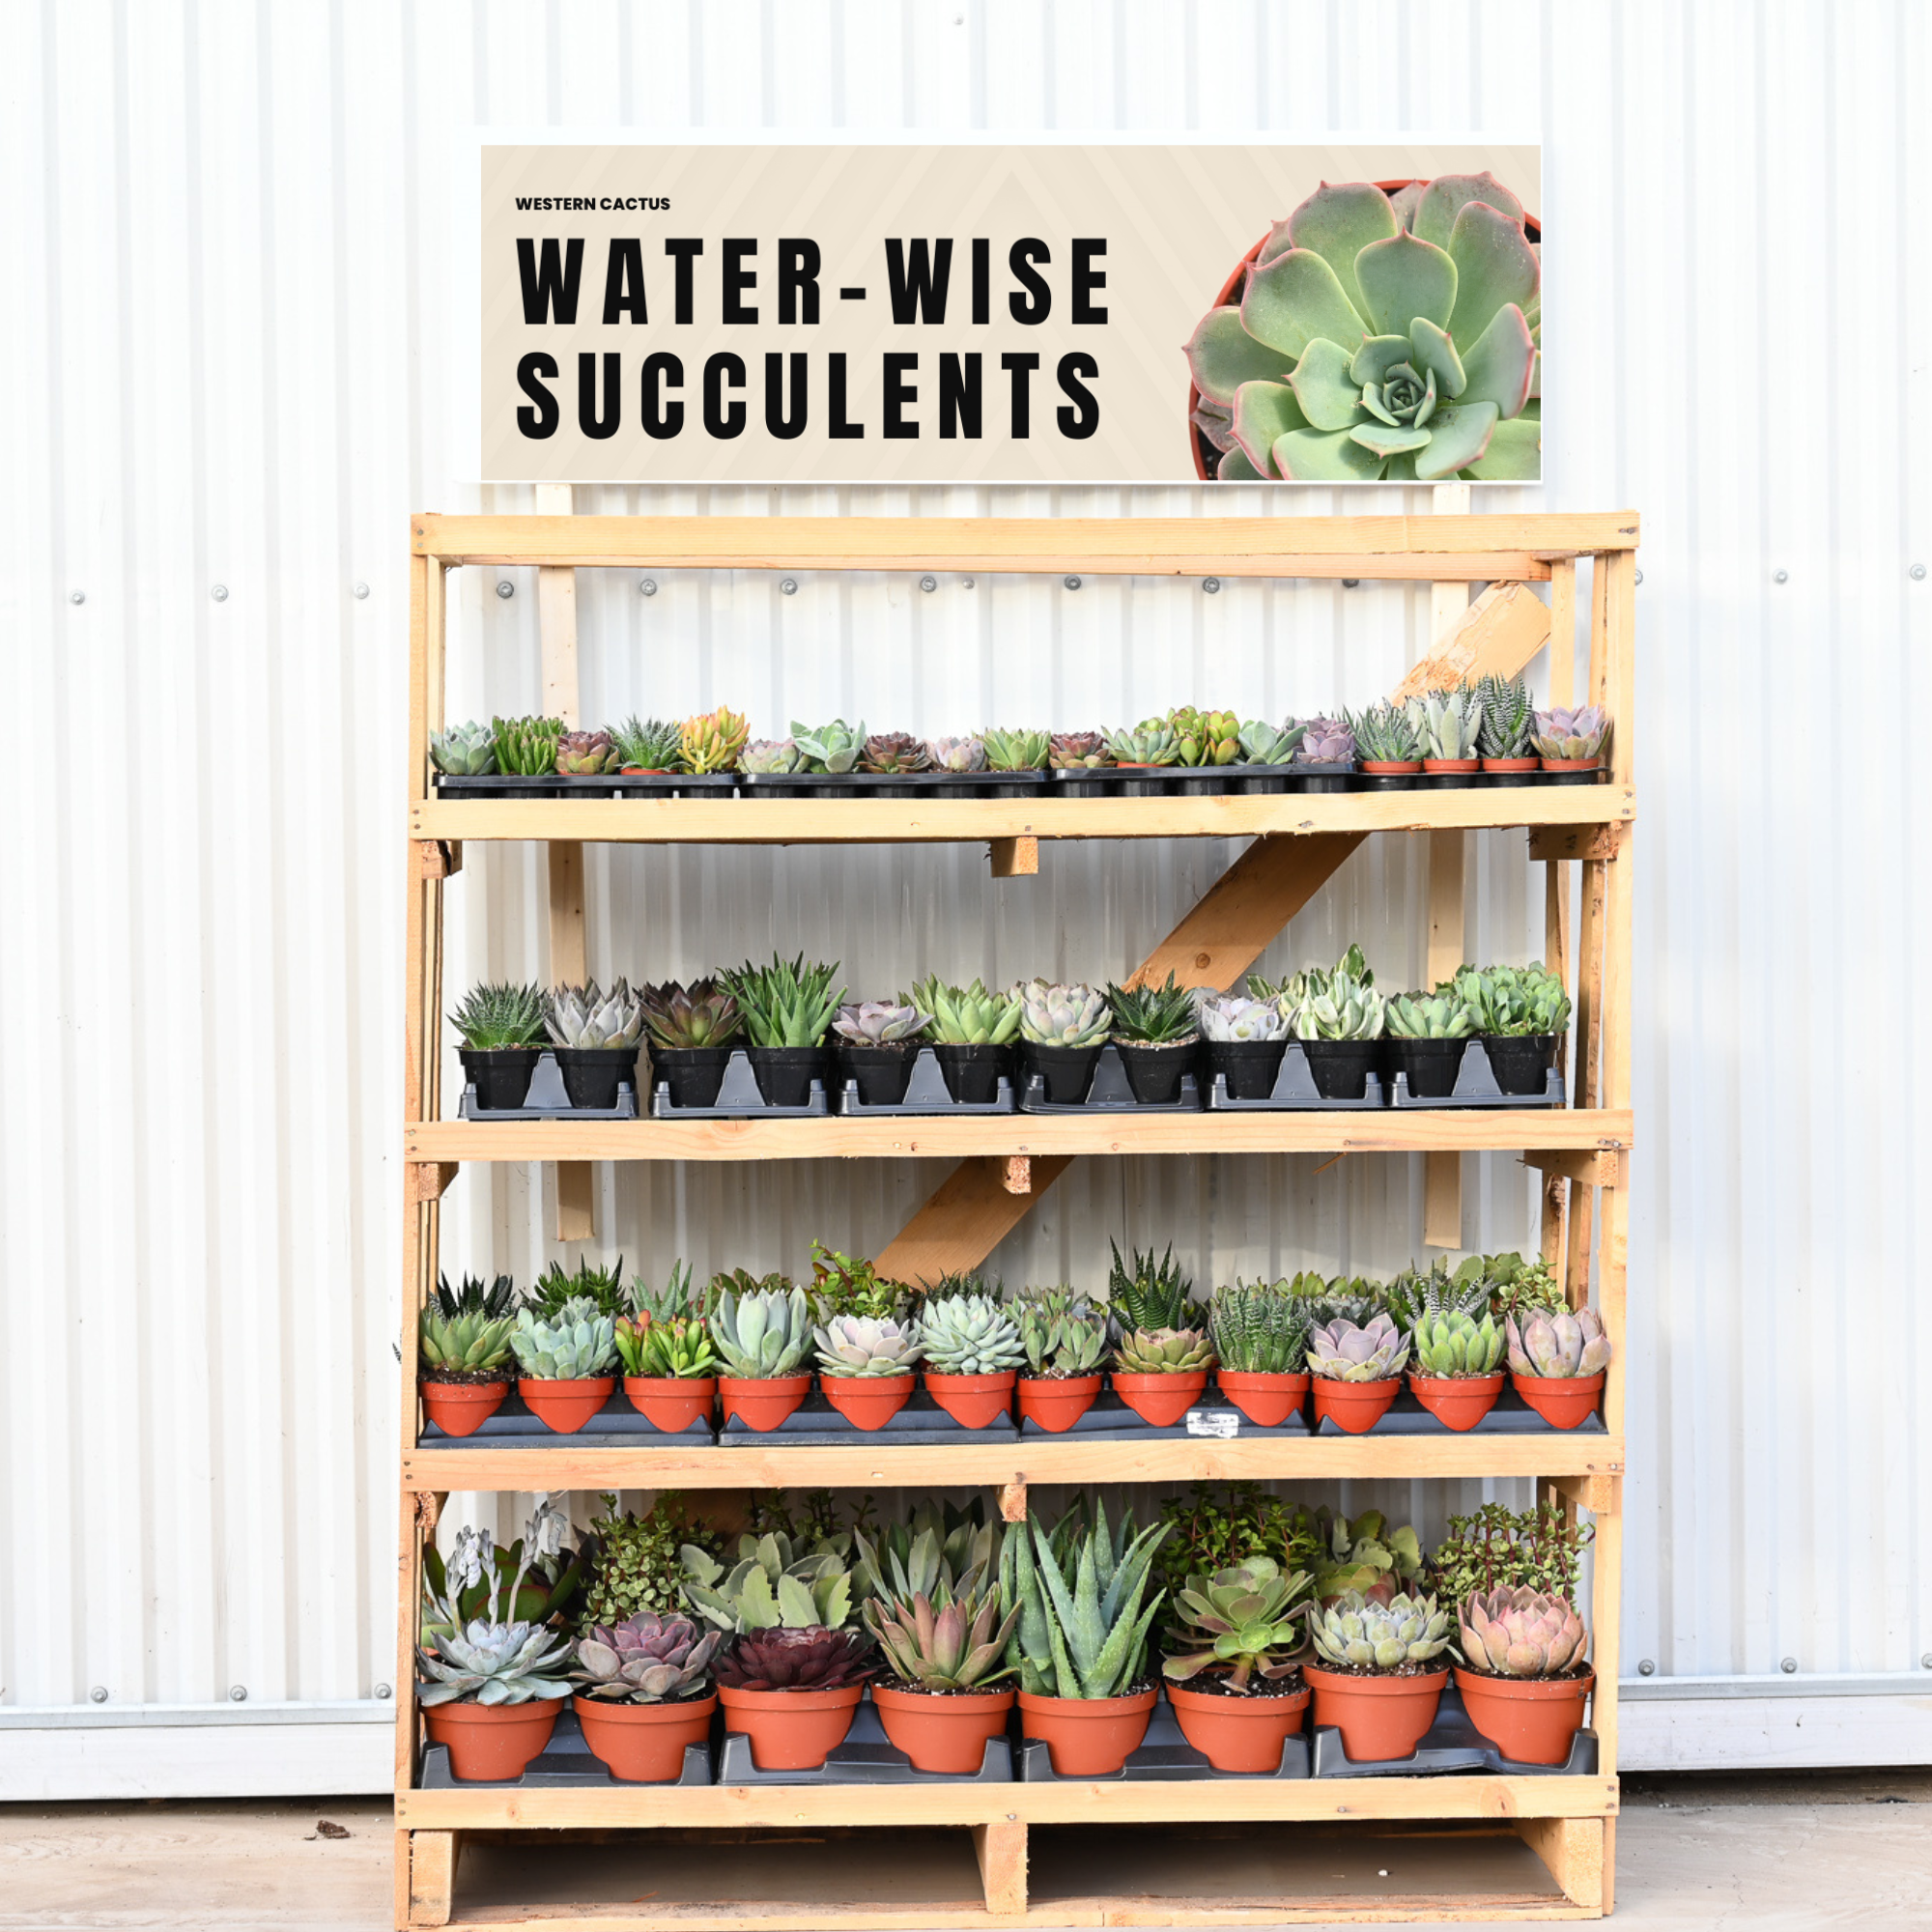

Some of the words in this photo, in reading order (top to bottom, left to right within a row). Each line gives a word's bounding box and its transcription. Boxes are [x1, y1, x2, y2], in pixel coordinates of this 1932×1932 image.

[515, 197, 596, 211] WESTERN
[599, 197, 670, 211] CACTUS
[516, 237, 1109, 326] WATER-WISE
[516, 351, 1100, 440] SUCCULENTS
